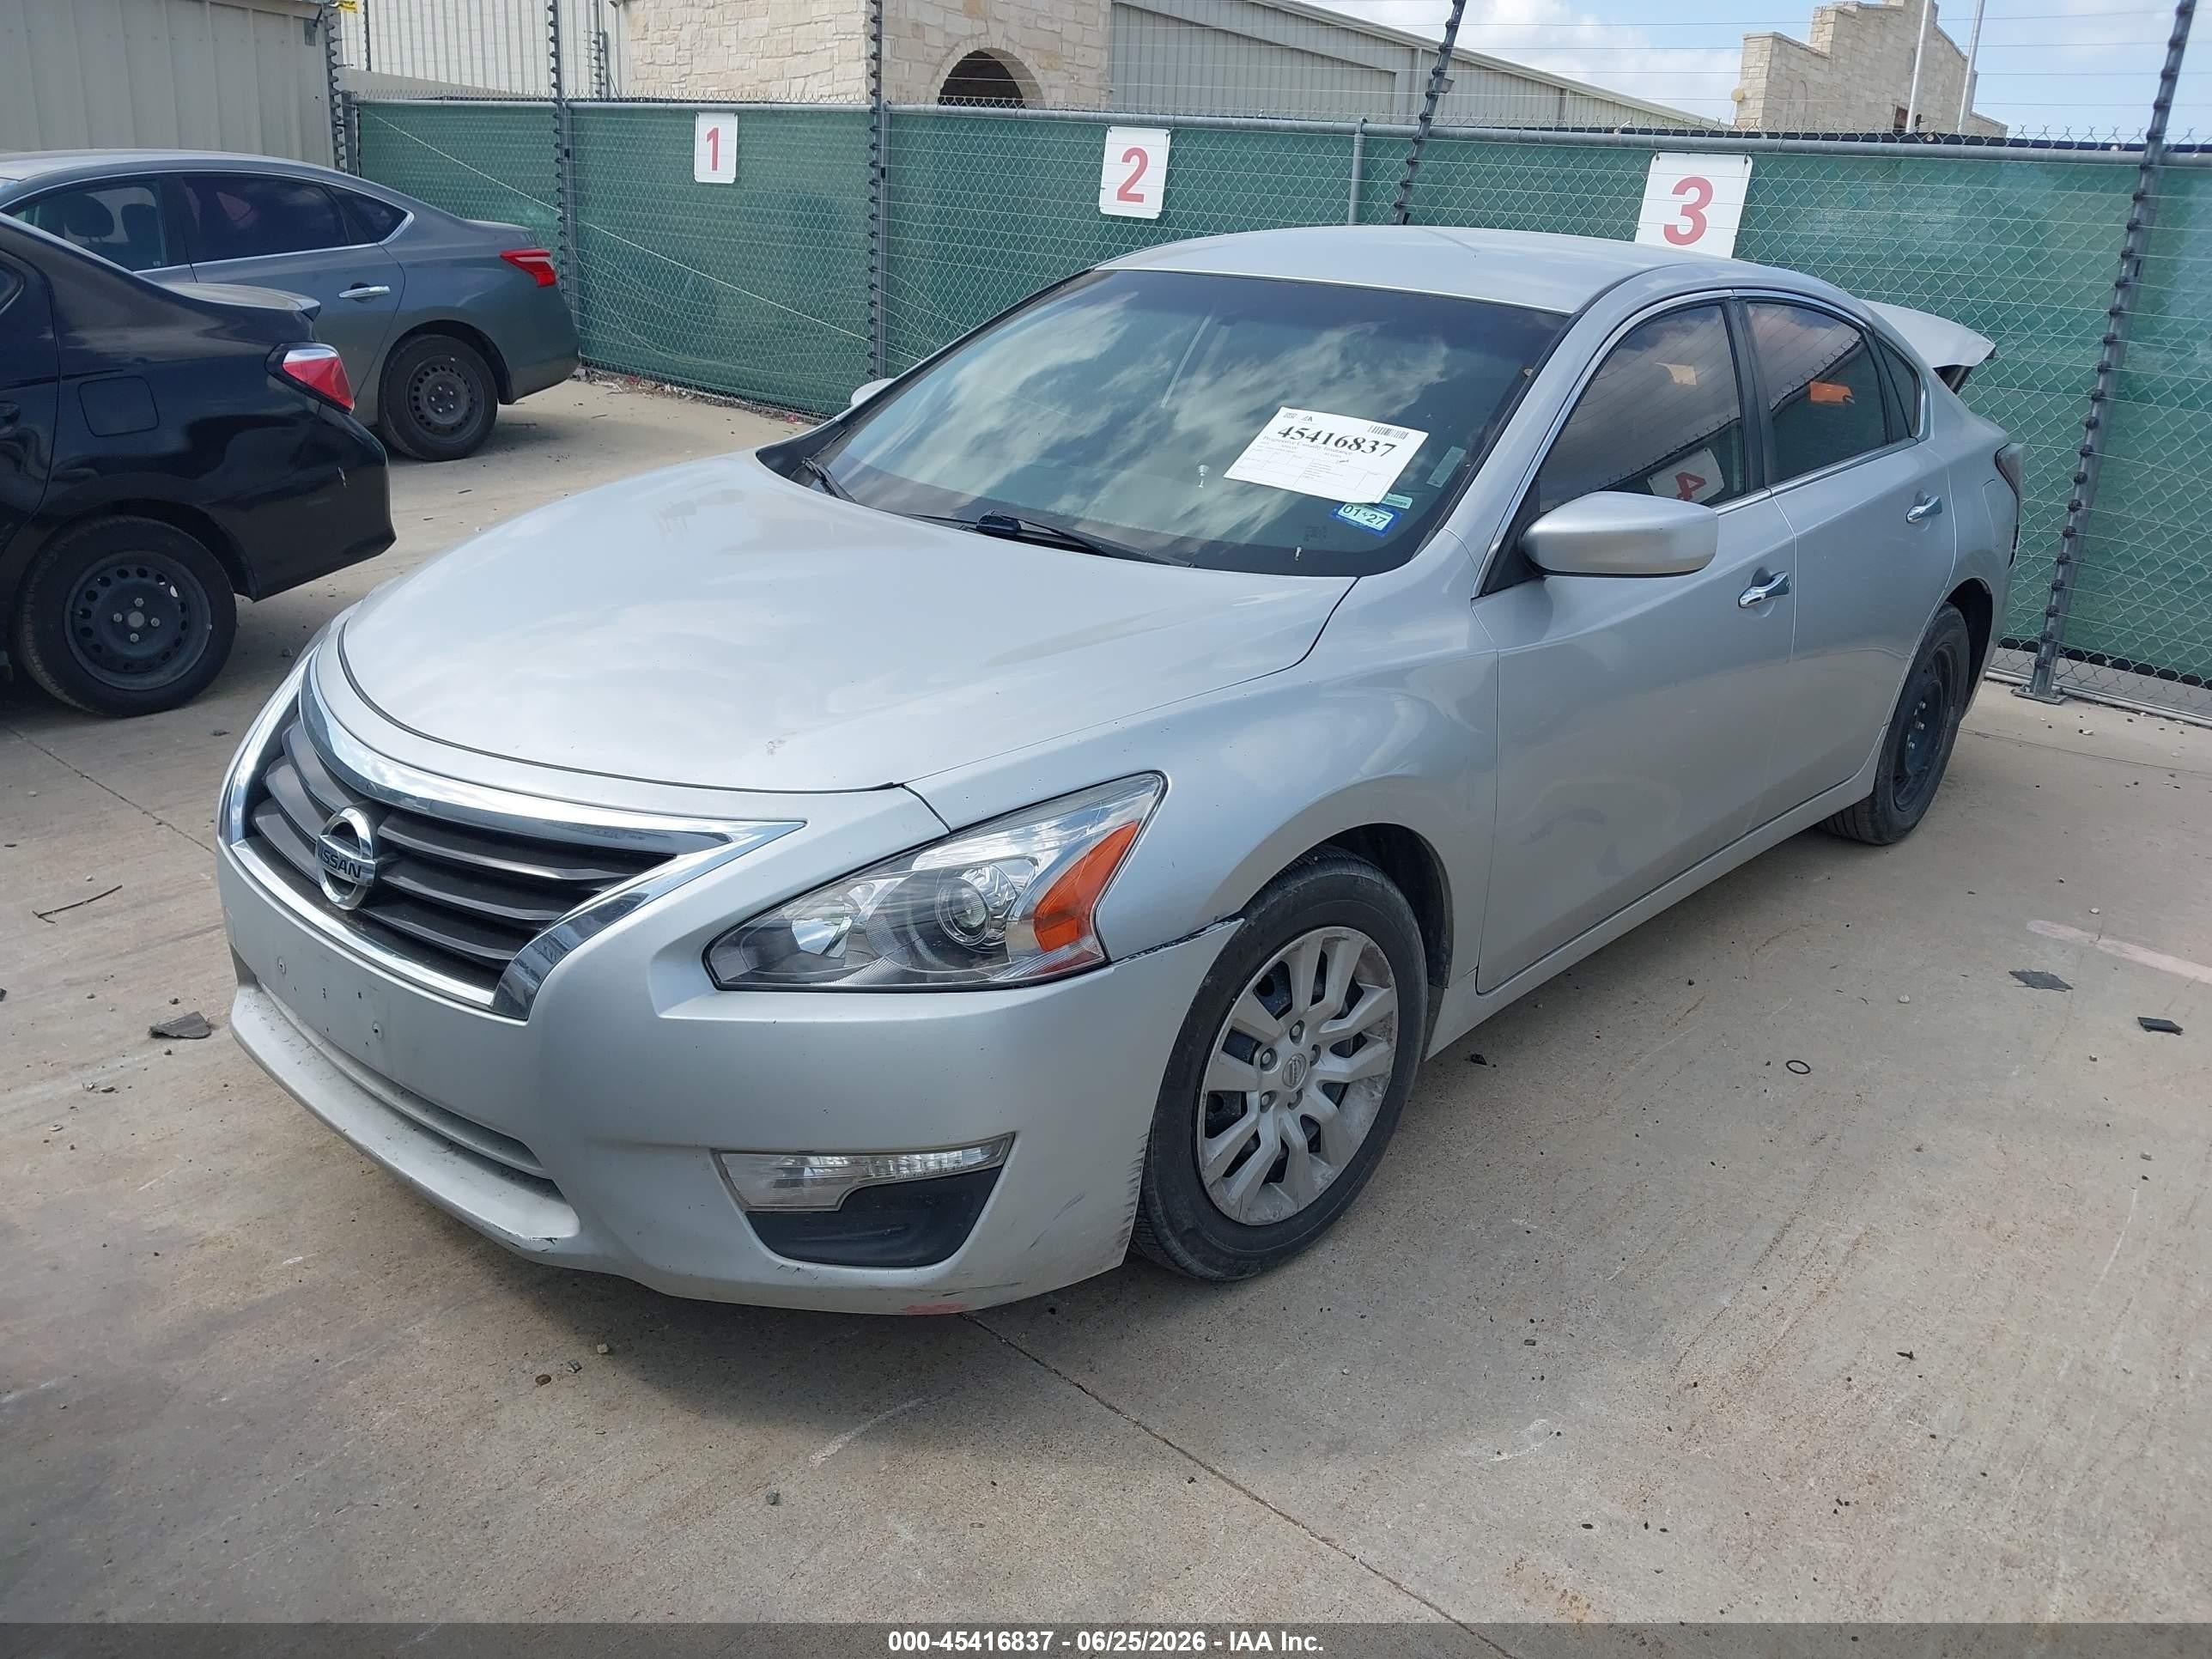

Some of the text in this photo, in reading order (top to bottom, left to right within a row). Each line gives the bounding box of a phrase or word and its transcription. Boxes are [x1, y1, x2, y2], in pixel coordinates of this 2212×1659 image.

[706, 127, 719, 171] 1
[1116, 147, 1148, 203] 2
[1663, 176, 1714, 246] 3
[1277, 425, 1398, 458] 45416837
